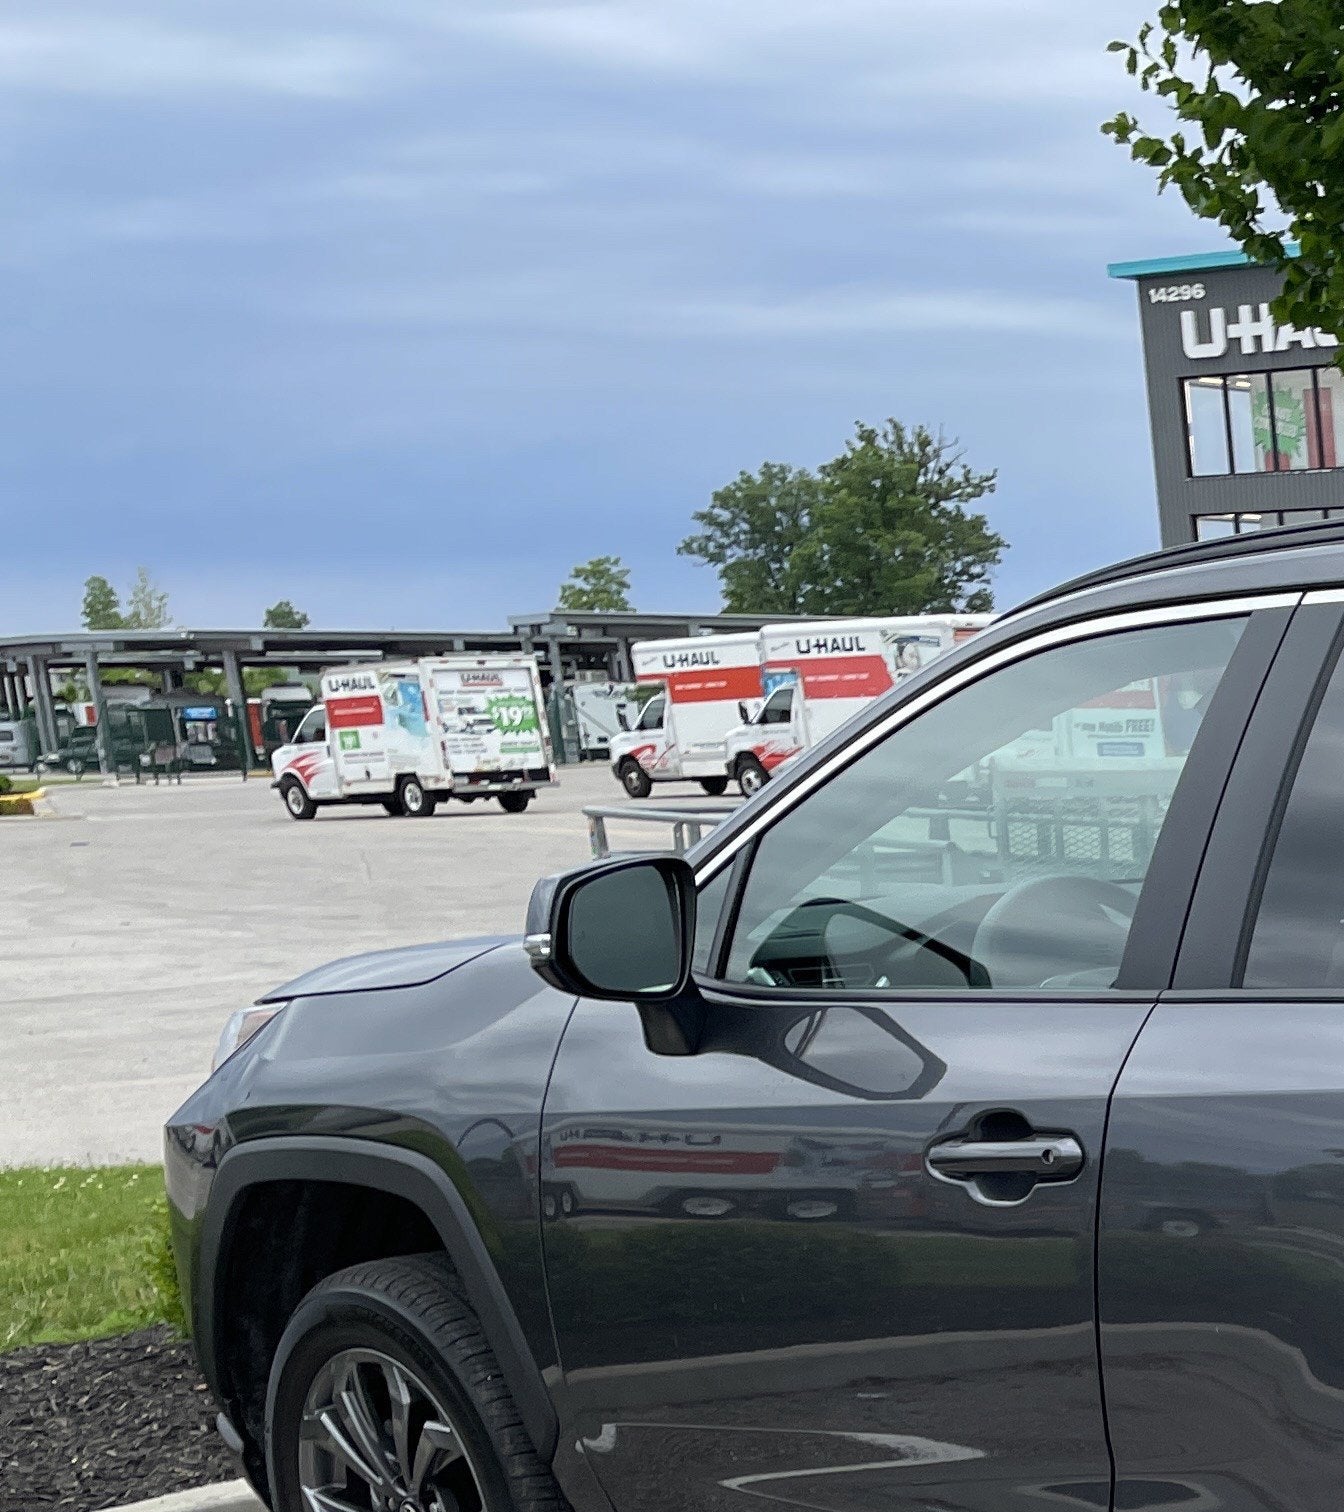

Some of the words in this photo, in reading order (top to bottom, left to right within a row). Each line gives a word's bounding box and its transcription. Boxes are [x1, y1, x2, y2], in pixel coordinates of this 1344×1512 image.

[1149, 283, 1206, 303] 14296
[1180, 302, 1340, 359] U-HA
[796, 636, 866, 654] U-HAUL
[663, 651, 721, 668] U-HAUL
[328, 675, 376, 692] U-HAUL
